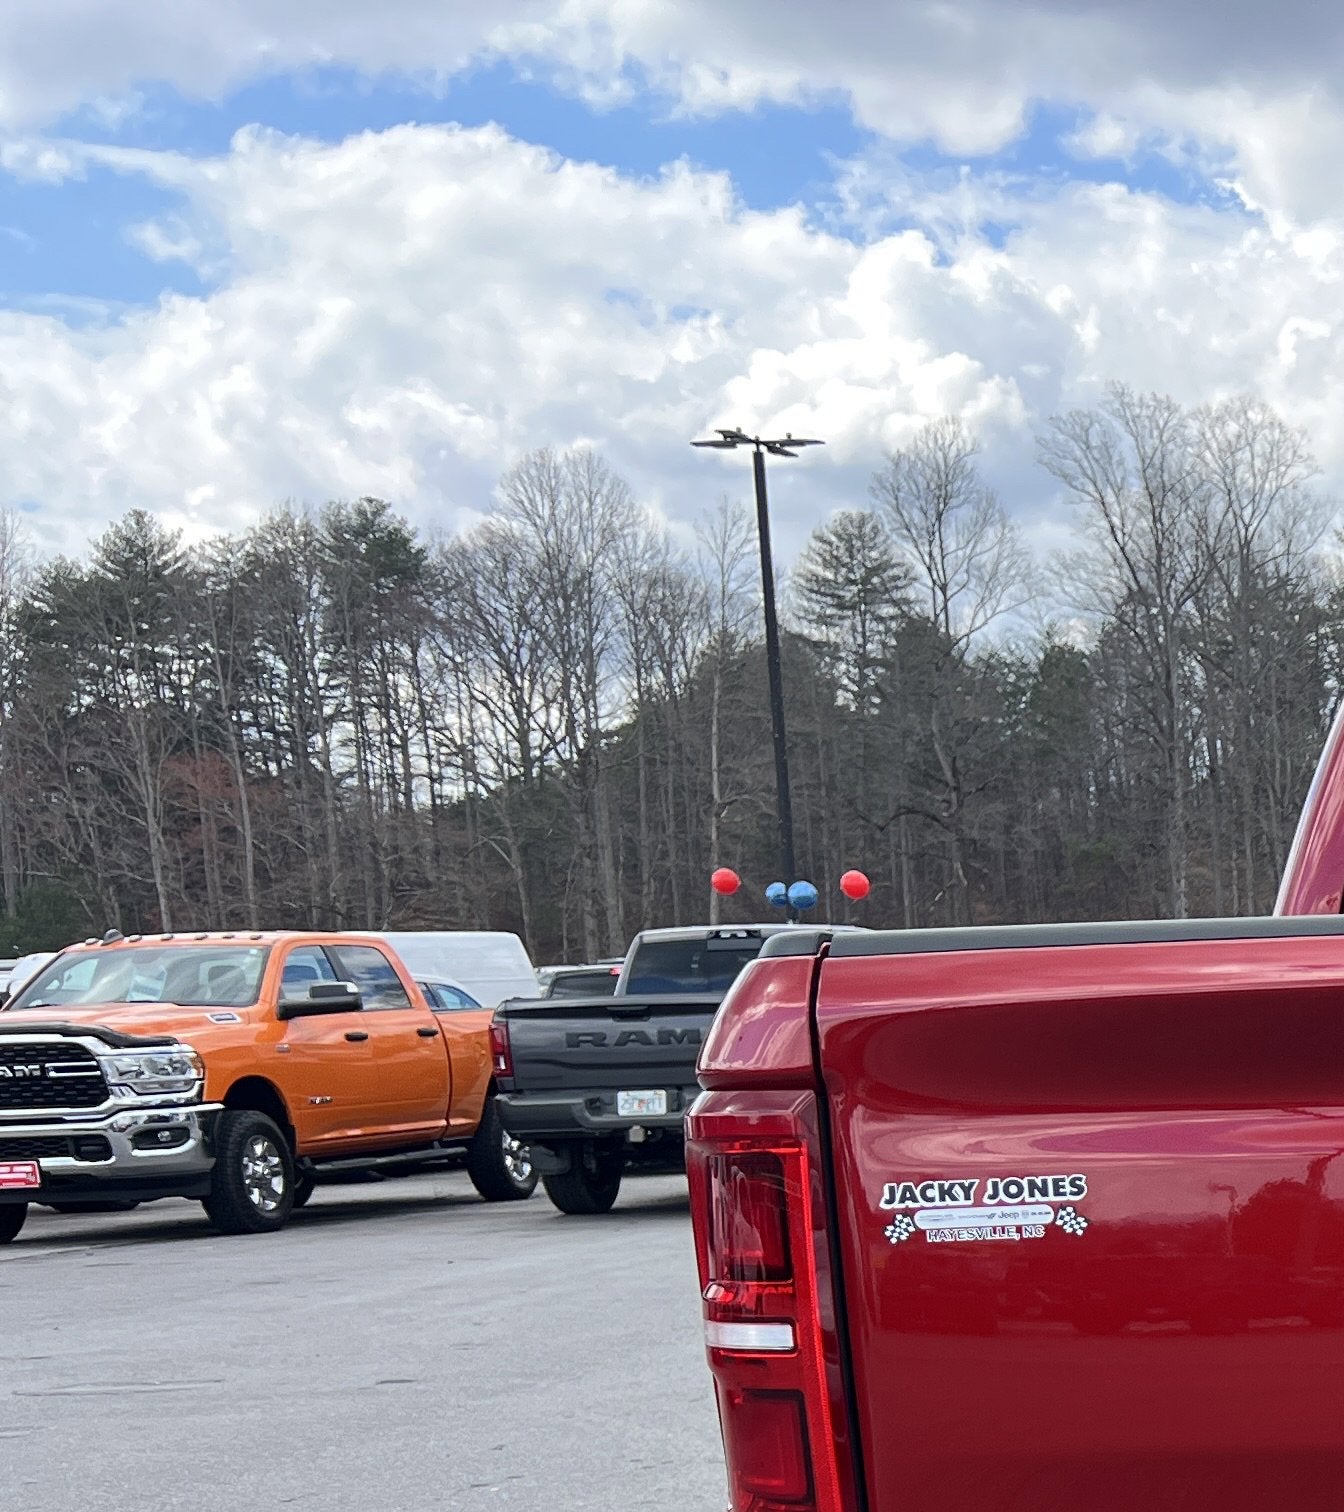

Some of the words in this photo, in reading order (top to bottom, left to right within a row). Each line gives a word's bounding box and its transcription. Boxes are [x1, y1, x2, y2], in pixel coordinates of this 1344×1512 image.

[565, 1028, 702, 1049] RAM
[0, 1064, 41, 1078] AM
[881, 1180, 978, 1208] JACKY
[984, 1174, 1087, 1202] JONES
[927, 1226, 1020, 1242] HAYESVILLE,
[1022, 1225, 1046, 1239] NC
